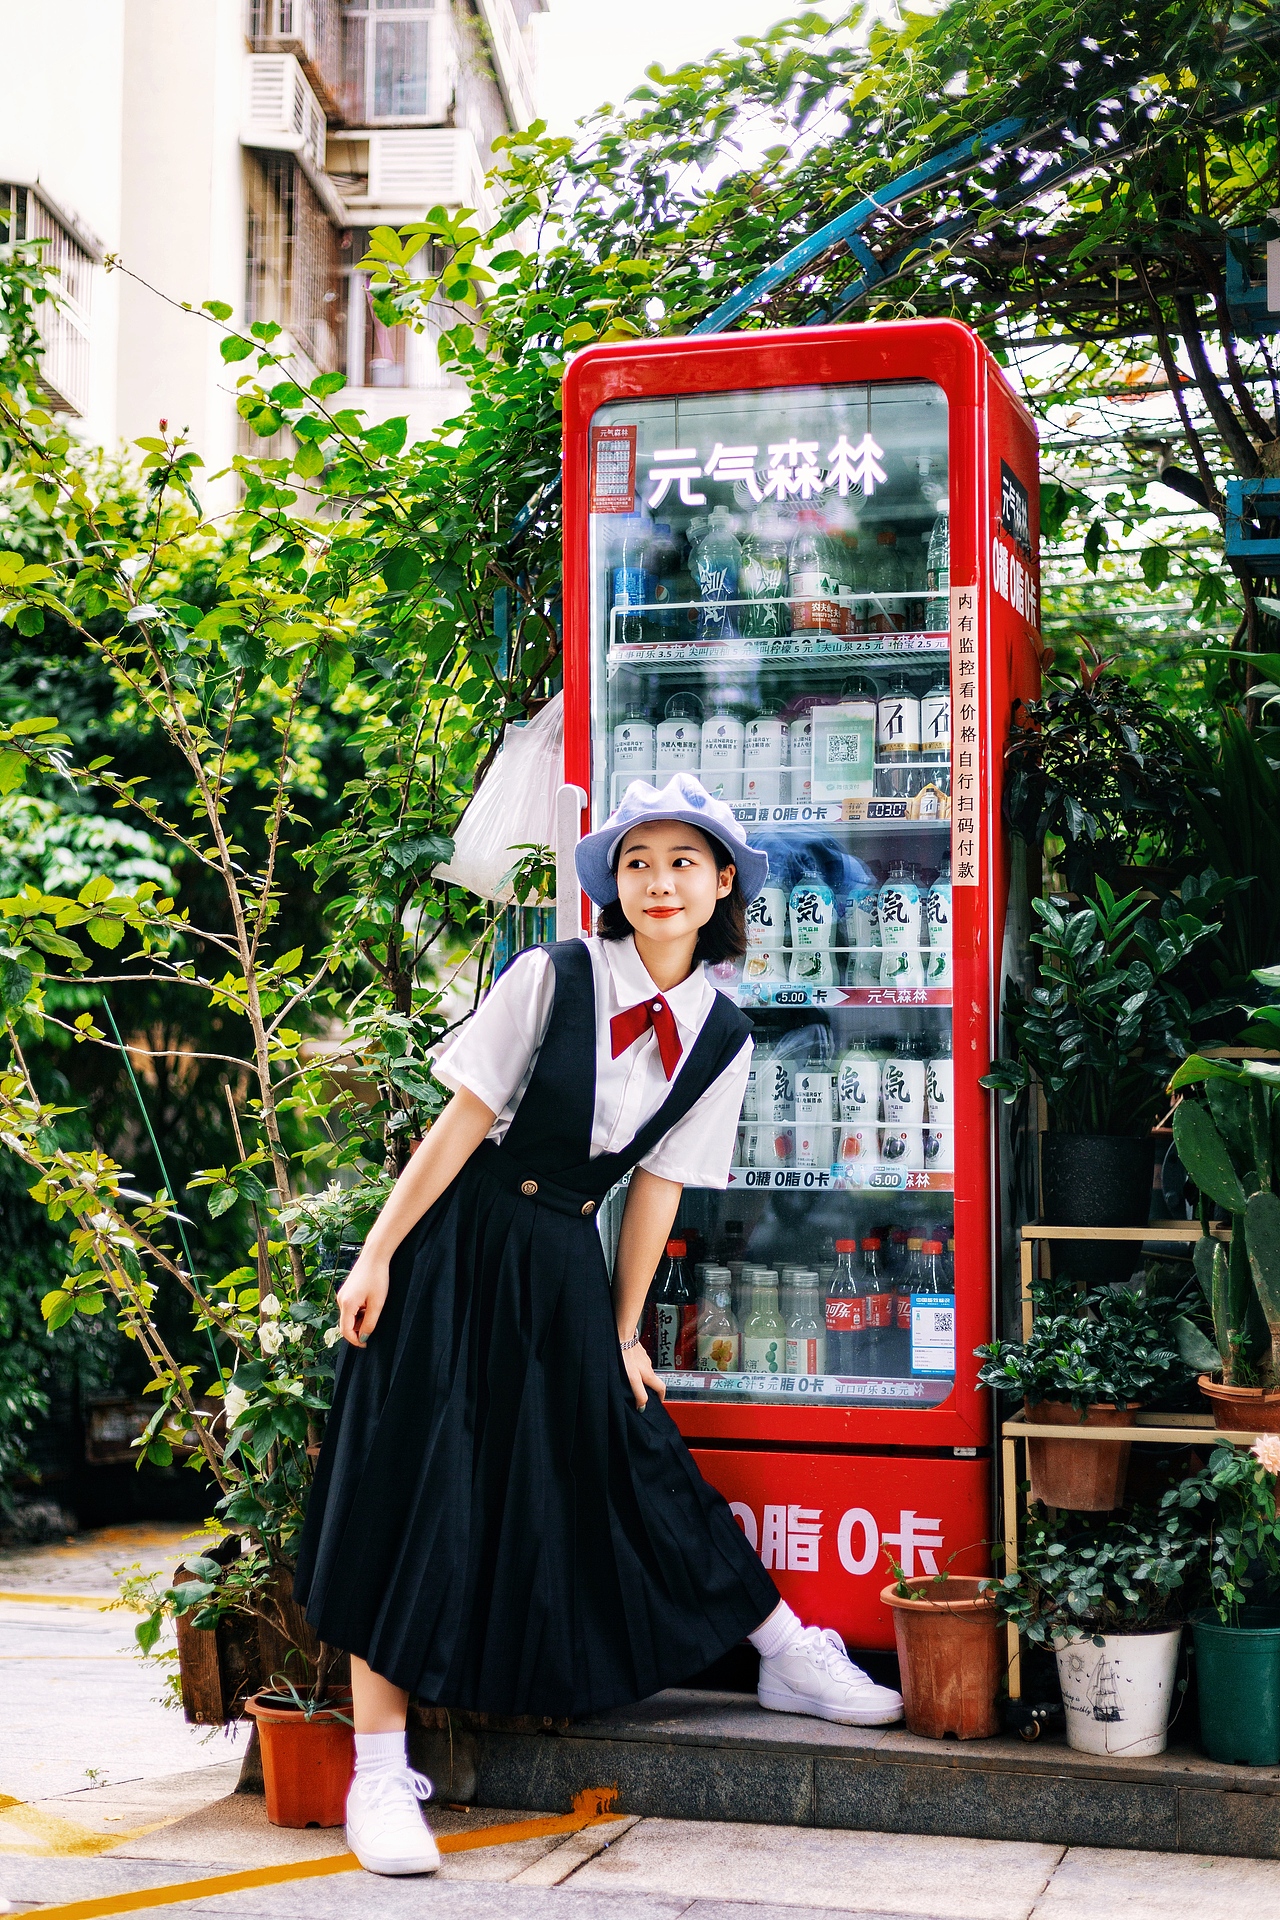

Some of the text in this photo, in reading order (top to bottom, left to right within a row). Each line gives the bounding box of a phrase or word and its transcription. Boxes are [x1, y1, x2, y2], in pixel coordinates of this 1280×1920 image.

[600, 429, 628, 437] 元气森林
[648, 433, 888, 508] 元气森林
[993, 536, 1009, 602] 0糖
[757, 645, 790, 656] 叫柠檬
[803, 644, 814, 653] 元
[818, 641, 853, 652] 夫山泉
[873, 641, 884, 650] 元
[888, 639, 915, 650] 怡宝
[917, 640, 931, 648] 2.5
[935, 639, 945, 649] 元
[674, 649, 685, 659] 元
[957, 593, 977, 880] 内有监控看价格自行扫码付款
[772, 808, 799, 821] 0脂
[801, 807, 828, 820] 0卡
[812, 989, 828, 1004] 卡
[867, 989, 928, 1004] 元气森林
[745, 1171, 830, 1187] 0糖 0脂 0卡
[658, 1308, 673, 1368] 和其正
[768, 1381, 777, 1390] 元
[798, 1378, 824, 1393] 0卡
[835, 1384, 878, 1395] 可口可乐
[881, 1387, 895, 1395] 3.5
[899, 1385, 909, 1396] 元
[836, 1507, 945, 1577] 0卡
